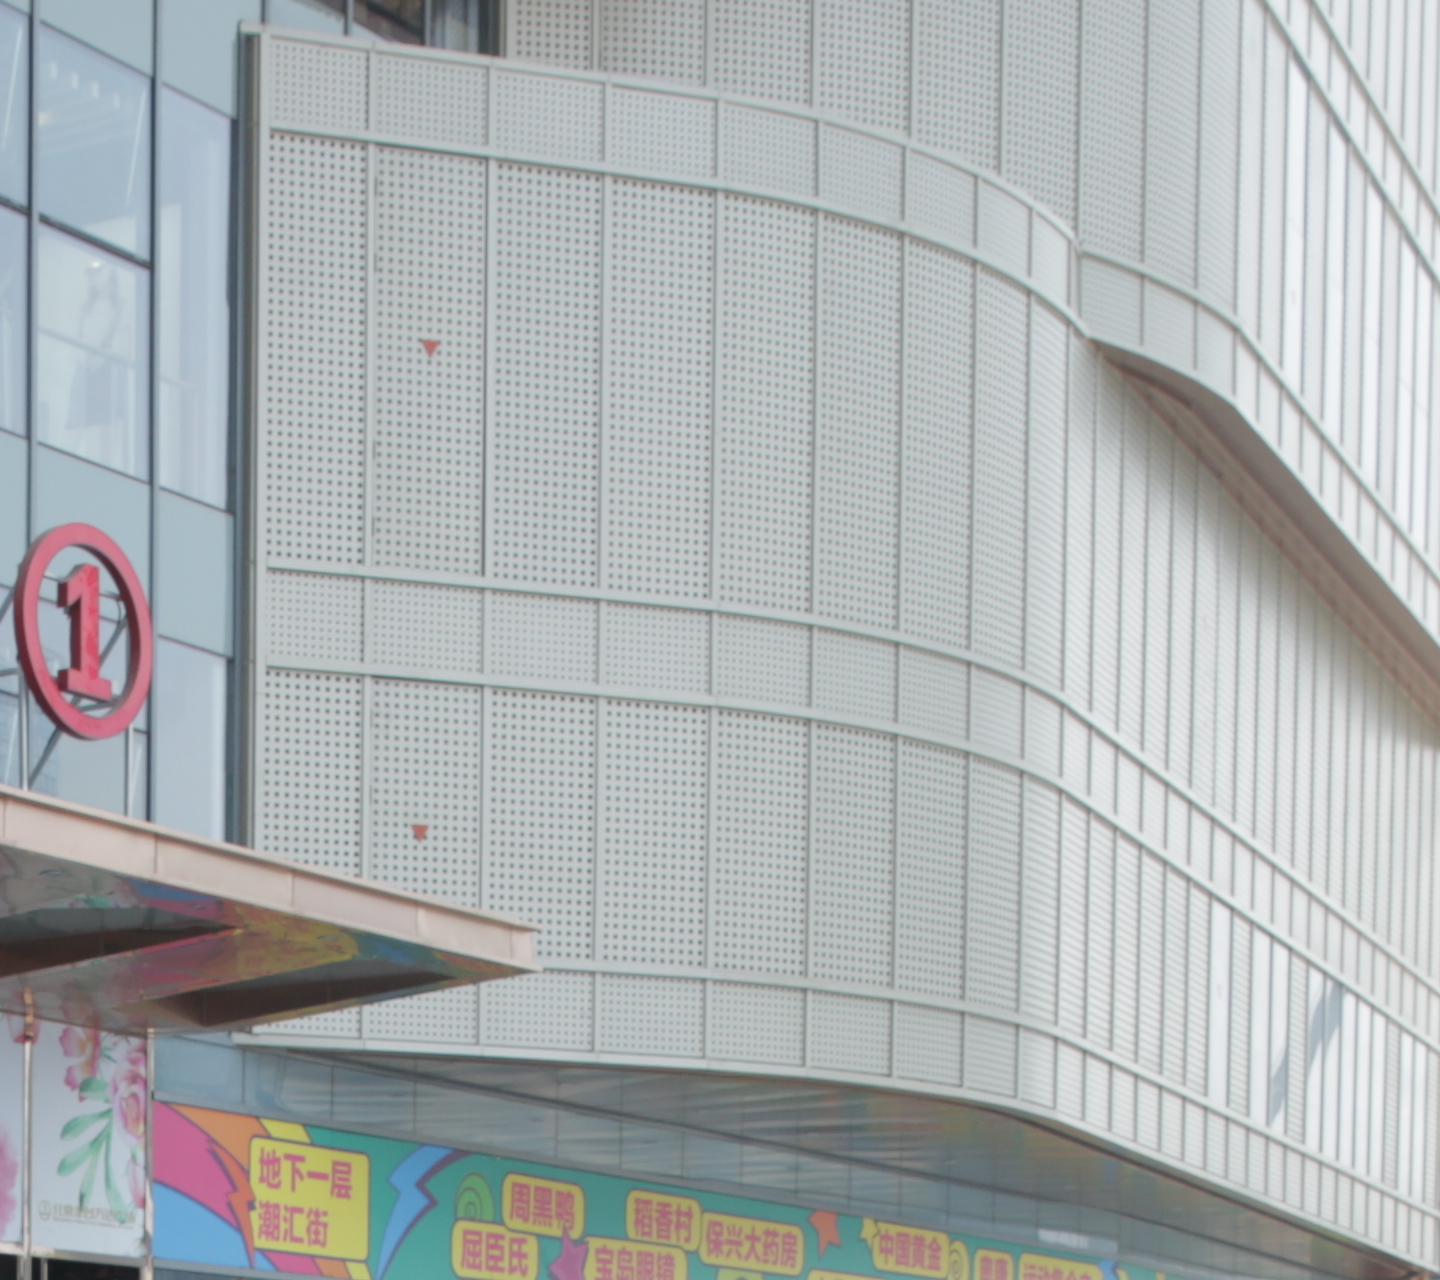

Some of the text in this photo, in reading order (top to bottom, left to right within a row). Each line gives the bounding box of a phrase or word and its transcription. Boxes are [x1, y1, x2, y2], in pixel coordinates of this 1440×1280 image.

[56, 565, 112, 702] 1
[257, 1147, 353, 1201] 地下一层
[257, 1198, 329, 1248] 潮汇街
[509, 1181, 576, 1233] 周黑鸭
[633, 1197, 694, 1244] 稻香村
[461, 1228, 529, 1278] 屈臣氏
[878, 1229, 942, 1272] 中国黄金
